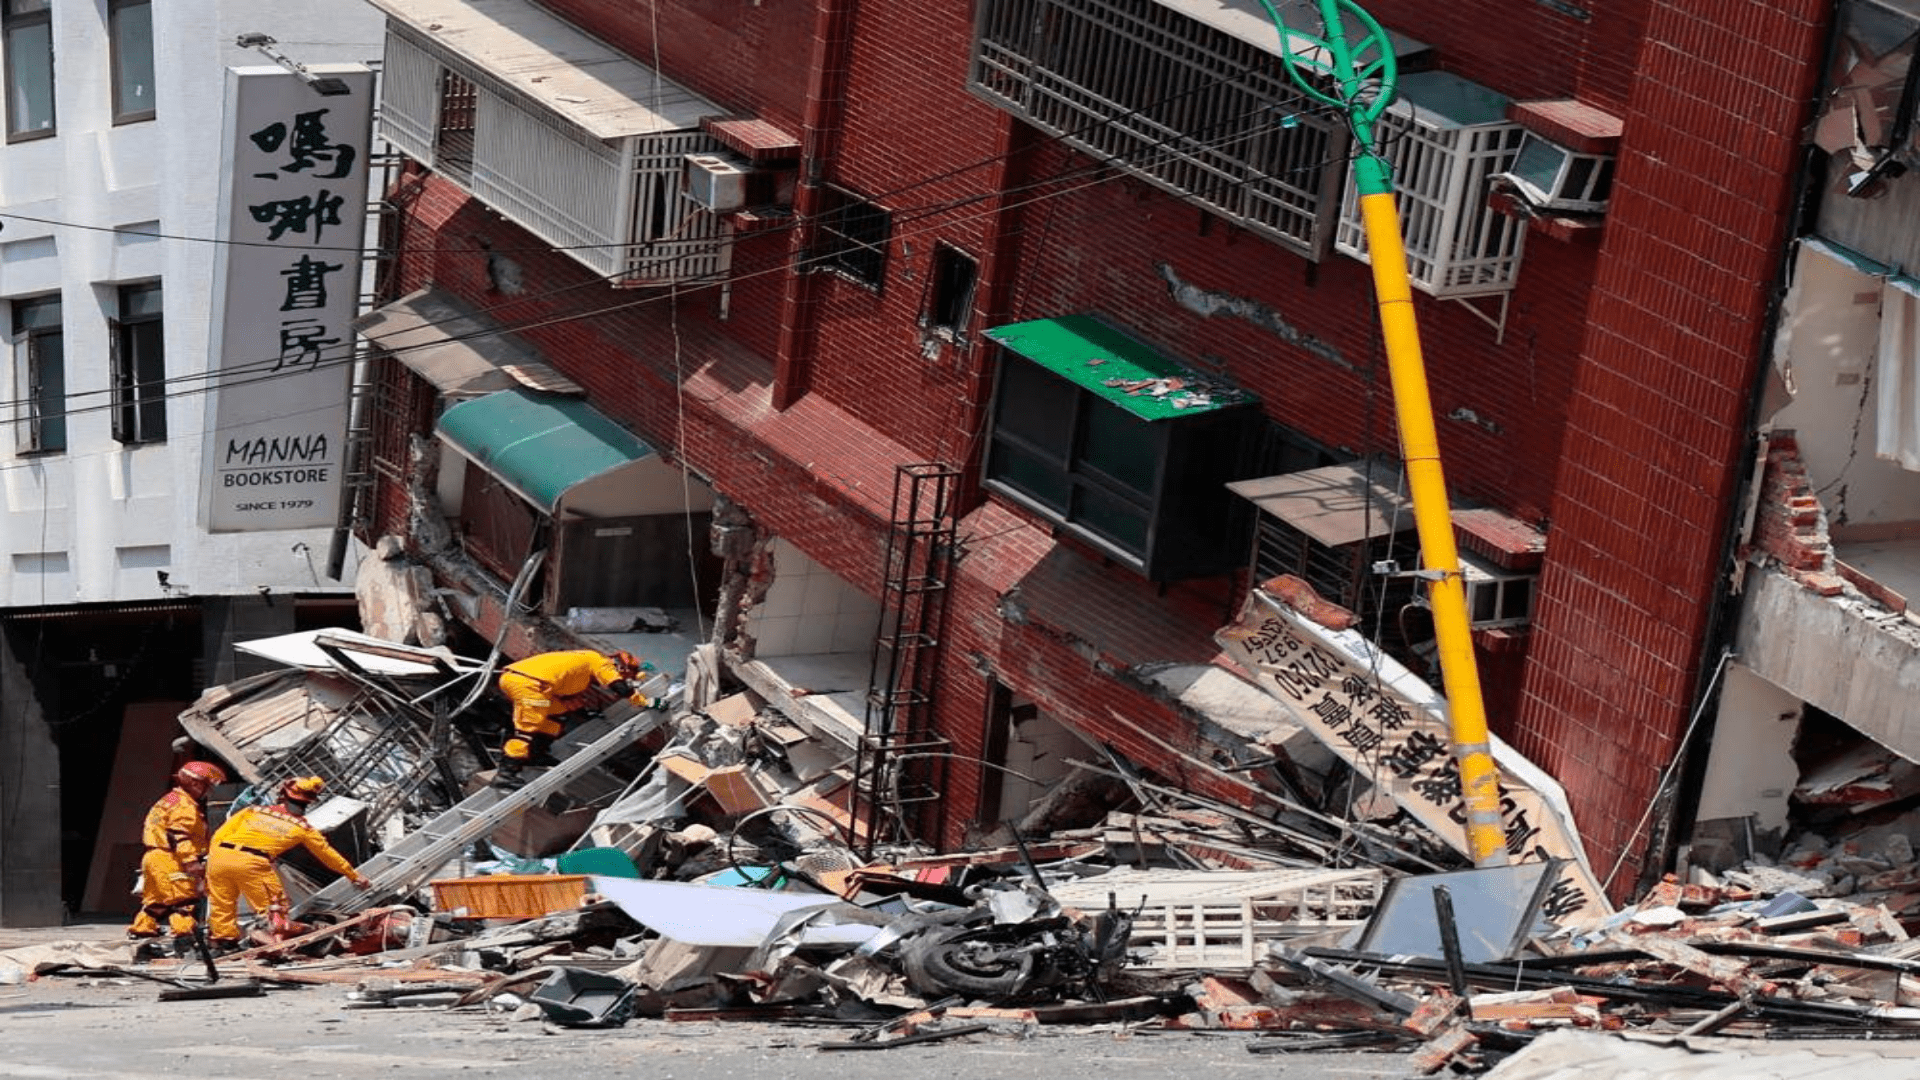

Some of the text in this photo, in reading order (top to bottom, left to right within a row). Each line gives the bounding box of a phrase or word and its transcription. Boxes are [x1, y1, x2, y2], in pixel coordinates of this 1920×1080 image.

[248, 108, 356, 373] 嗎哪書房
[226, 433, 328, 465] MANNA
[223, 468, 329, 487] BOOKSTORE
[235, 499, 314, 511] SINCE 1979
